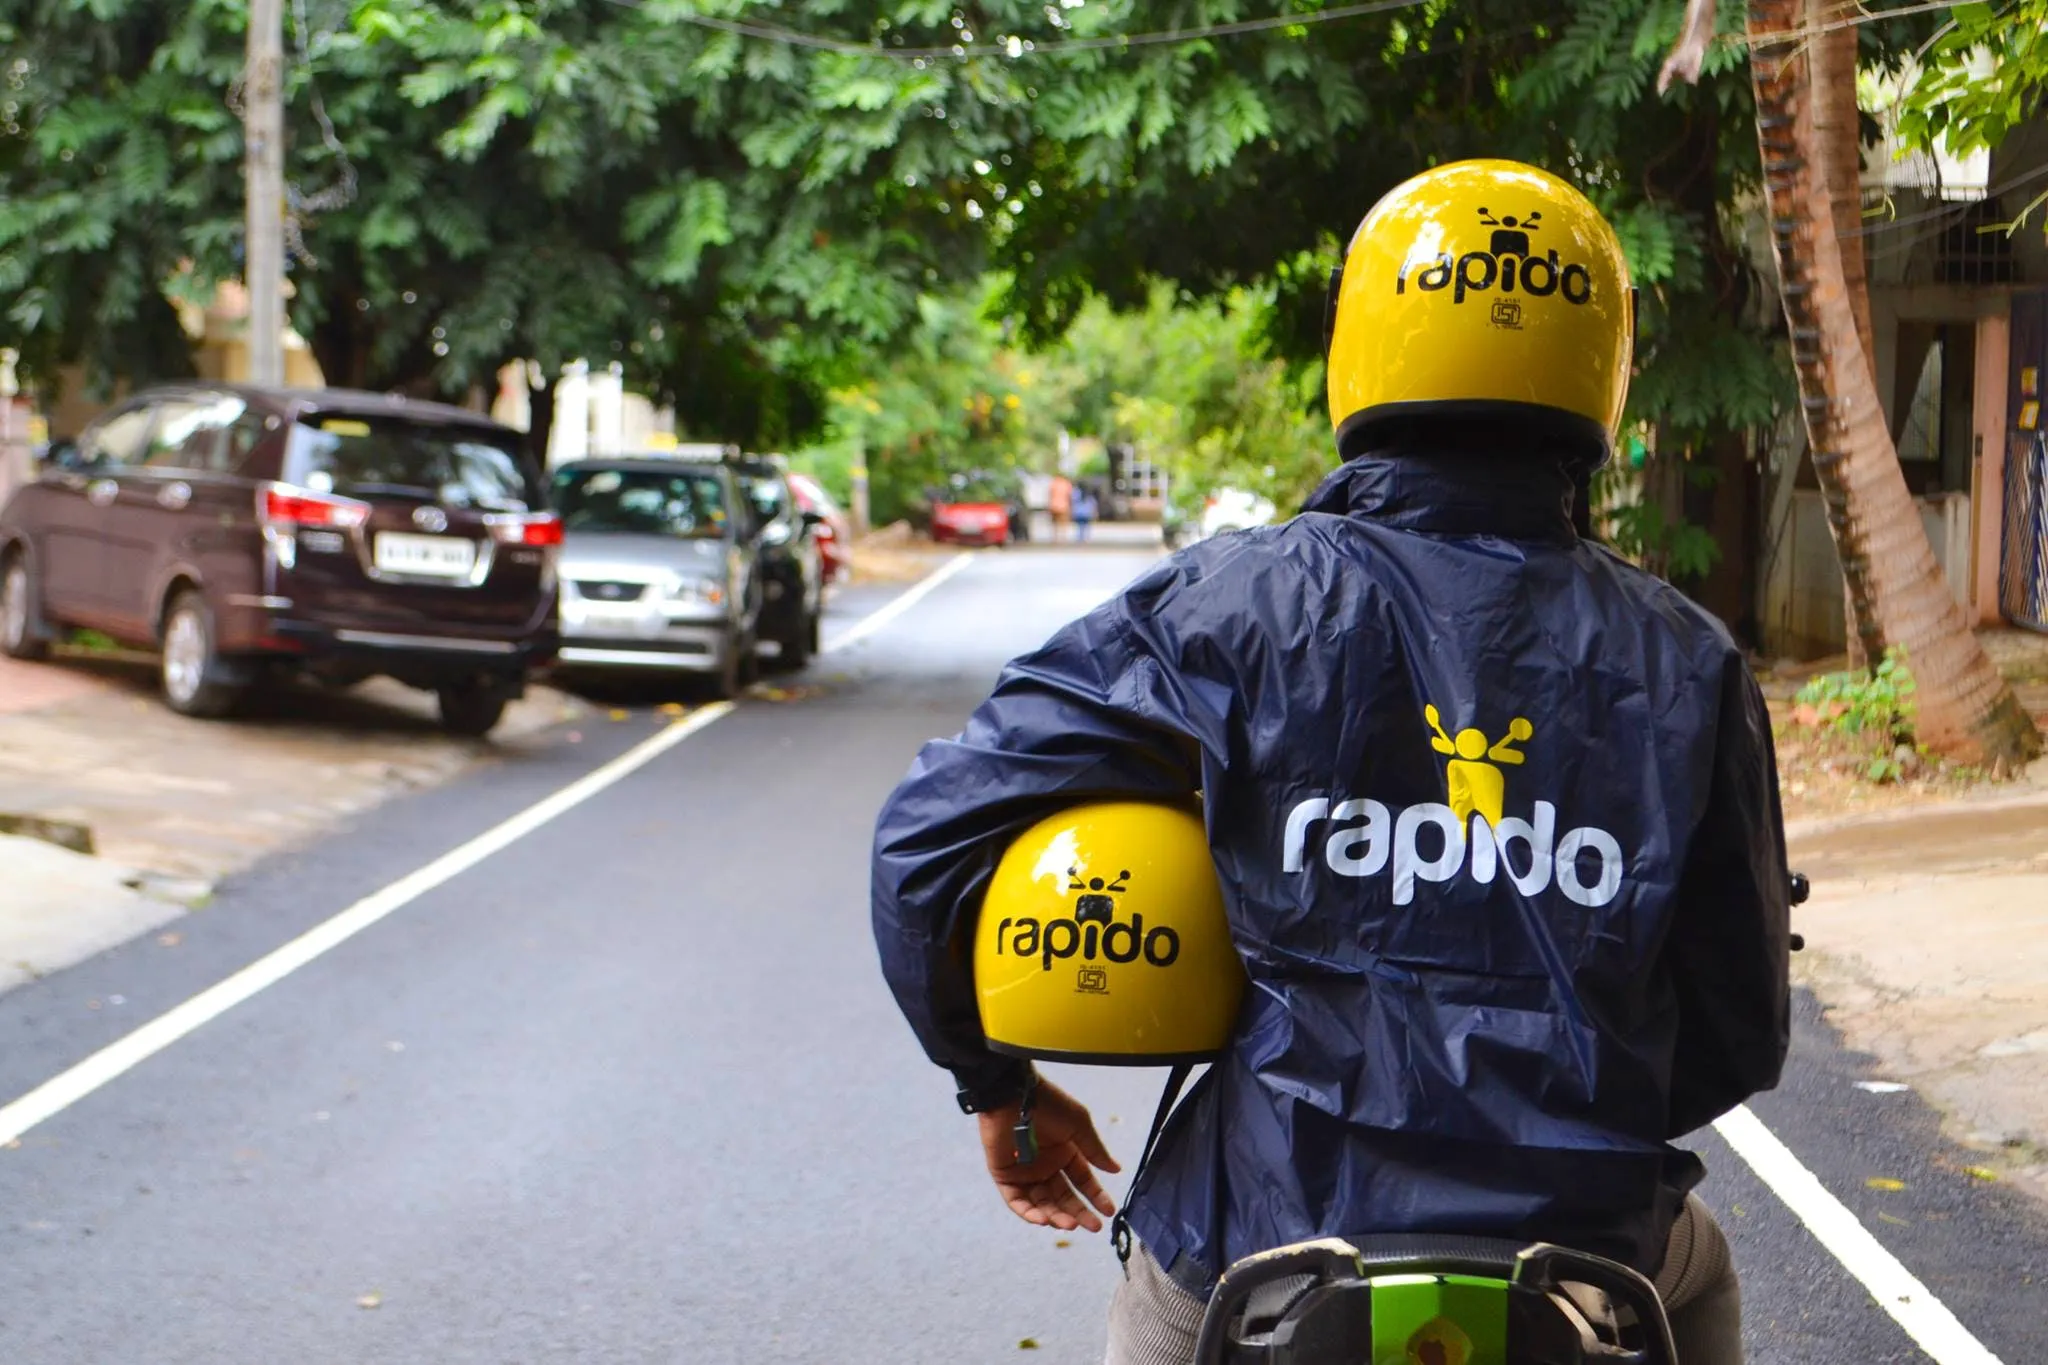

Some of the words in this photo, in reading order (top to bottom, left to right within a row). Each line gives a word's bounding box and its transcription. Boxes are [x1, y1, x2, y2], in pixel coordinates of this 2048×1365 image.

[1397, 249, 1591, 305] rapido
[1283, 798, 1624, 907] rapido
[998, 913, 1180, 971] rapido
